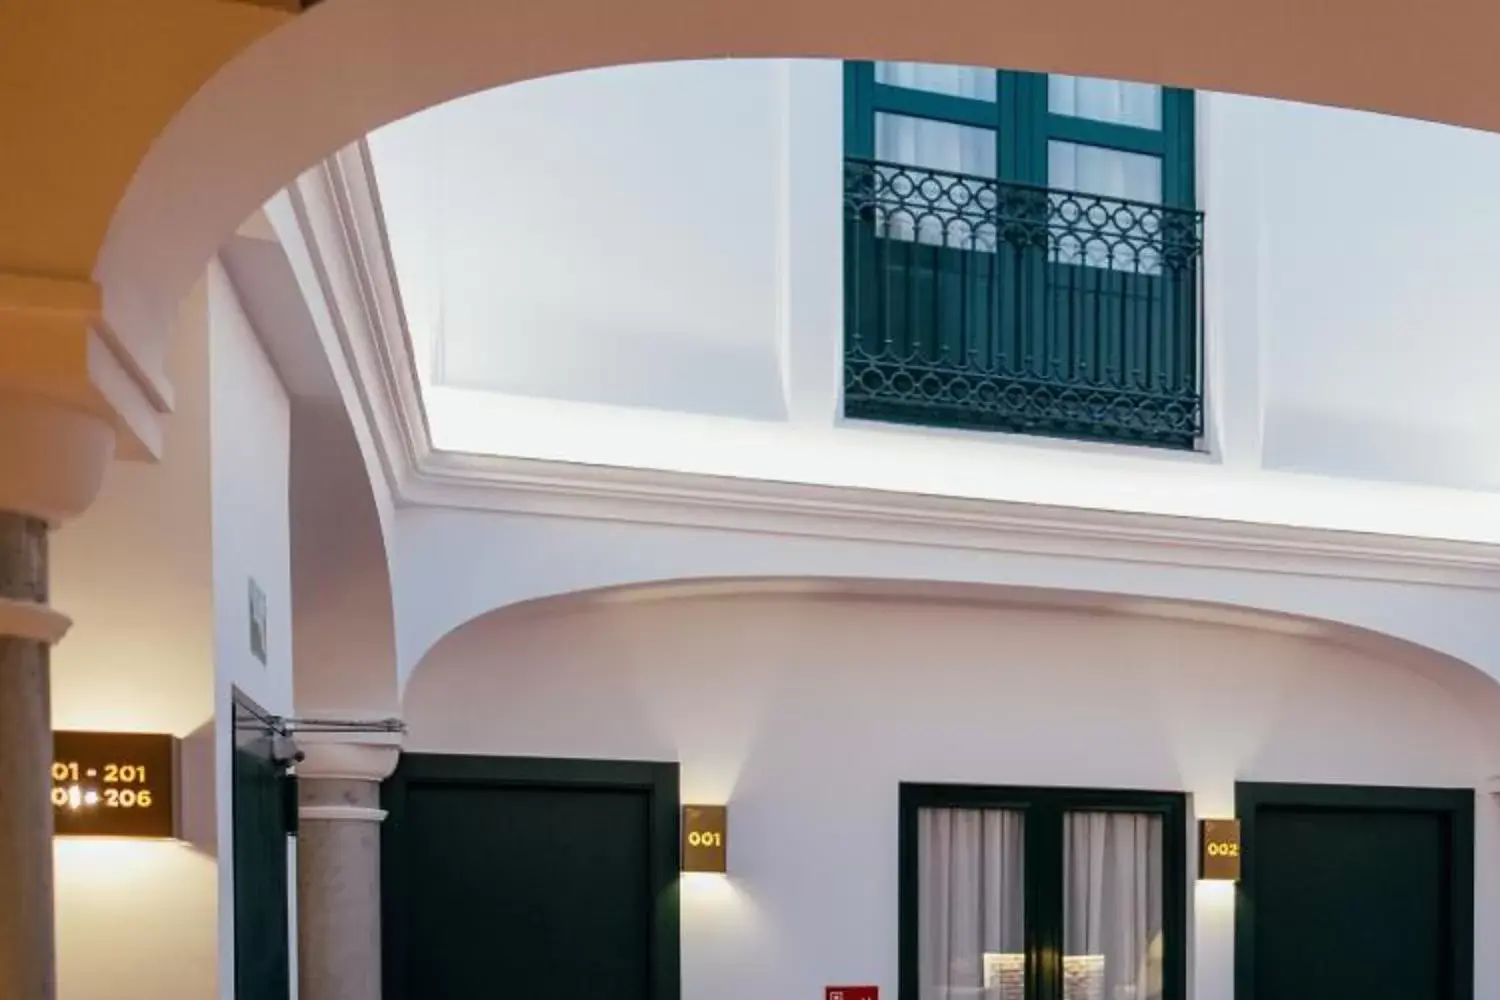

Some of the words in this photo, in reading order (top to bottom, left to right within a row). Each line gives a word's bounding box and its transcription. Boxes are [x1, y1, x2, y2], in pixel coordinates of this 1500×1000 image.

[51, 761, 79, 781] 01
[103, 763, 145, 783] 201
[103, 787, 152, 807] 206
[688, 831, 720, 847] 001
[1207, 842, 1238, 857] 002
